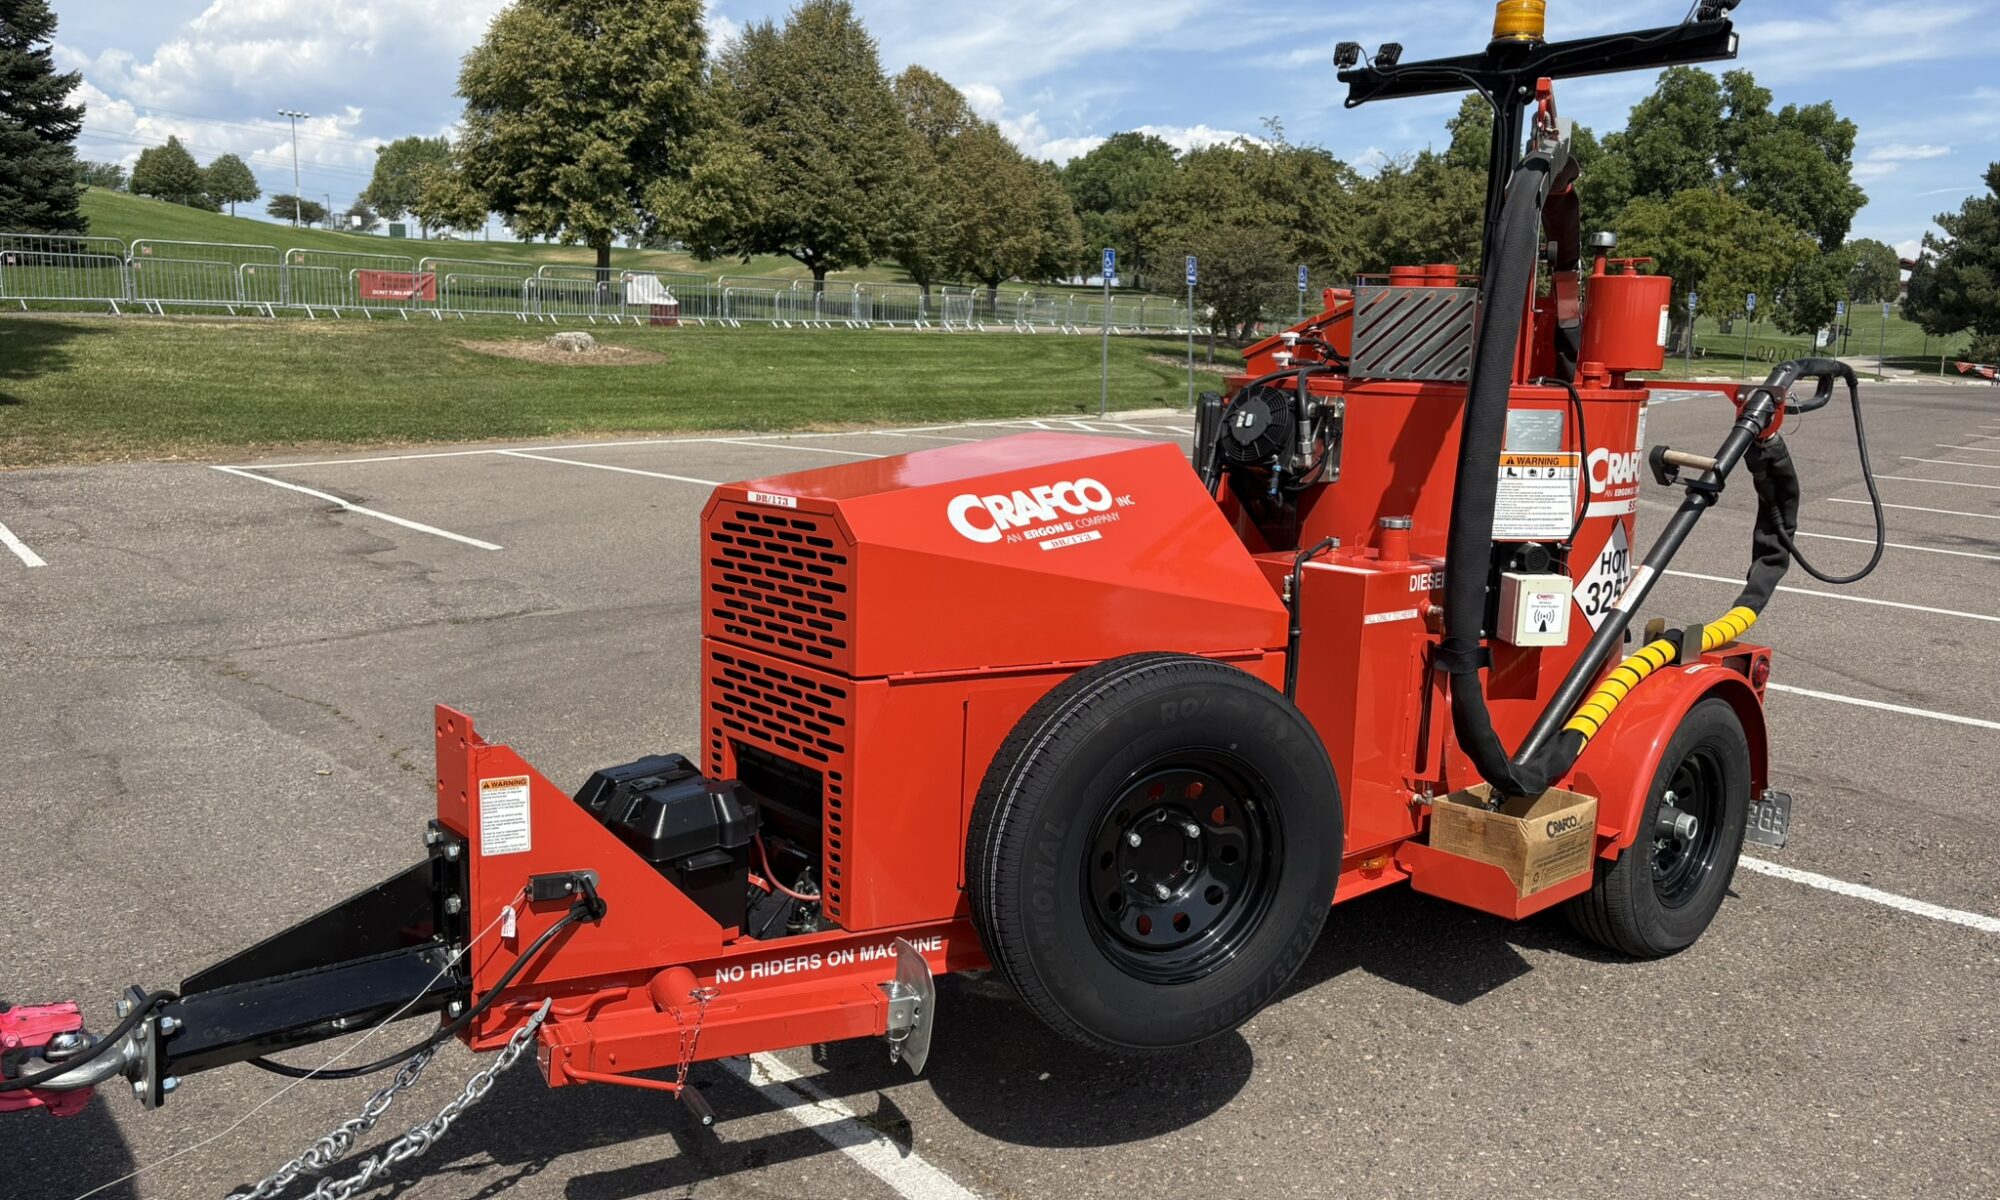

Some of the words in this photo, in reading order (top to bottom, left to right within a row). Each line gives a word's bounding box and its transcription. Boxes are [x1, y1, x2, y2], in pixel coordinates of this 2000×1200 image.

[1516, 456, 1560, 467] WARNING
[755, 493, 789, 506] DR/173
[946, 477, 1113, 544] CRAFCO
[1115, 494, 1136, 508] INC
[1006, 532, 1023, 545] AN
[1023, 523, 1066, 540] ERGON
[1075, 511, 1122, 530] COMPANY
[1050, 533, 1092, 547] DR/173
[1600, 548, 1628, 576] HOT
[1585, 576, 1629, 616] 325
[491, 778, 527, 789] WARNING
[1546, 814, 1578, 838] CRAFCO
[715, 965, 745, 984] NO
[750, 954, 822, 979] RIDERS
[827, 948, 855, 967] ON
[860, 935, 943, 962] MACINE
